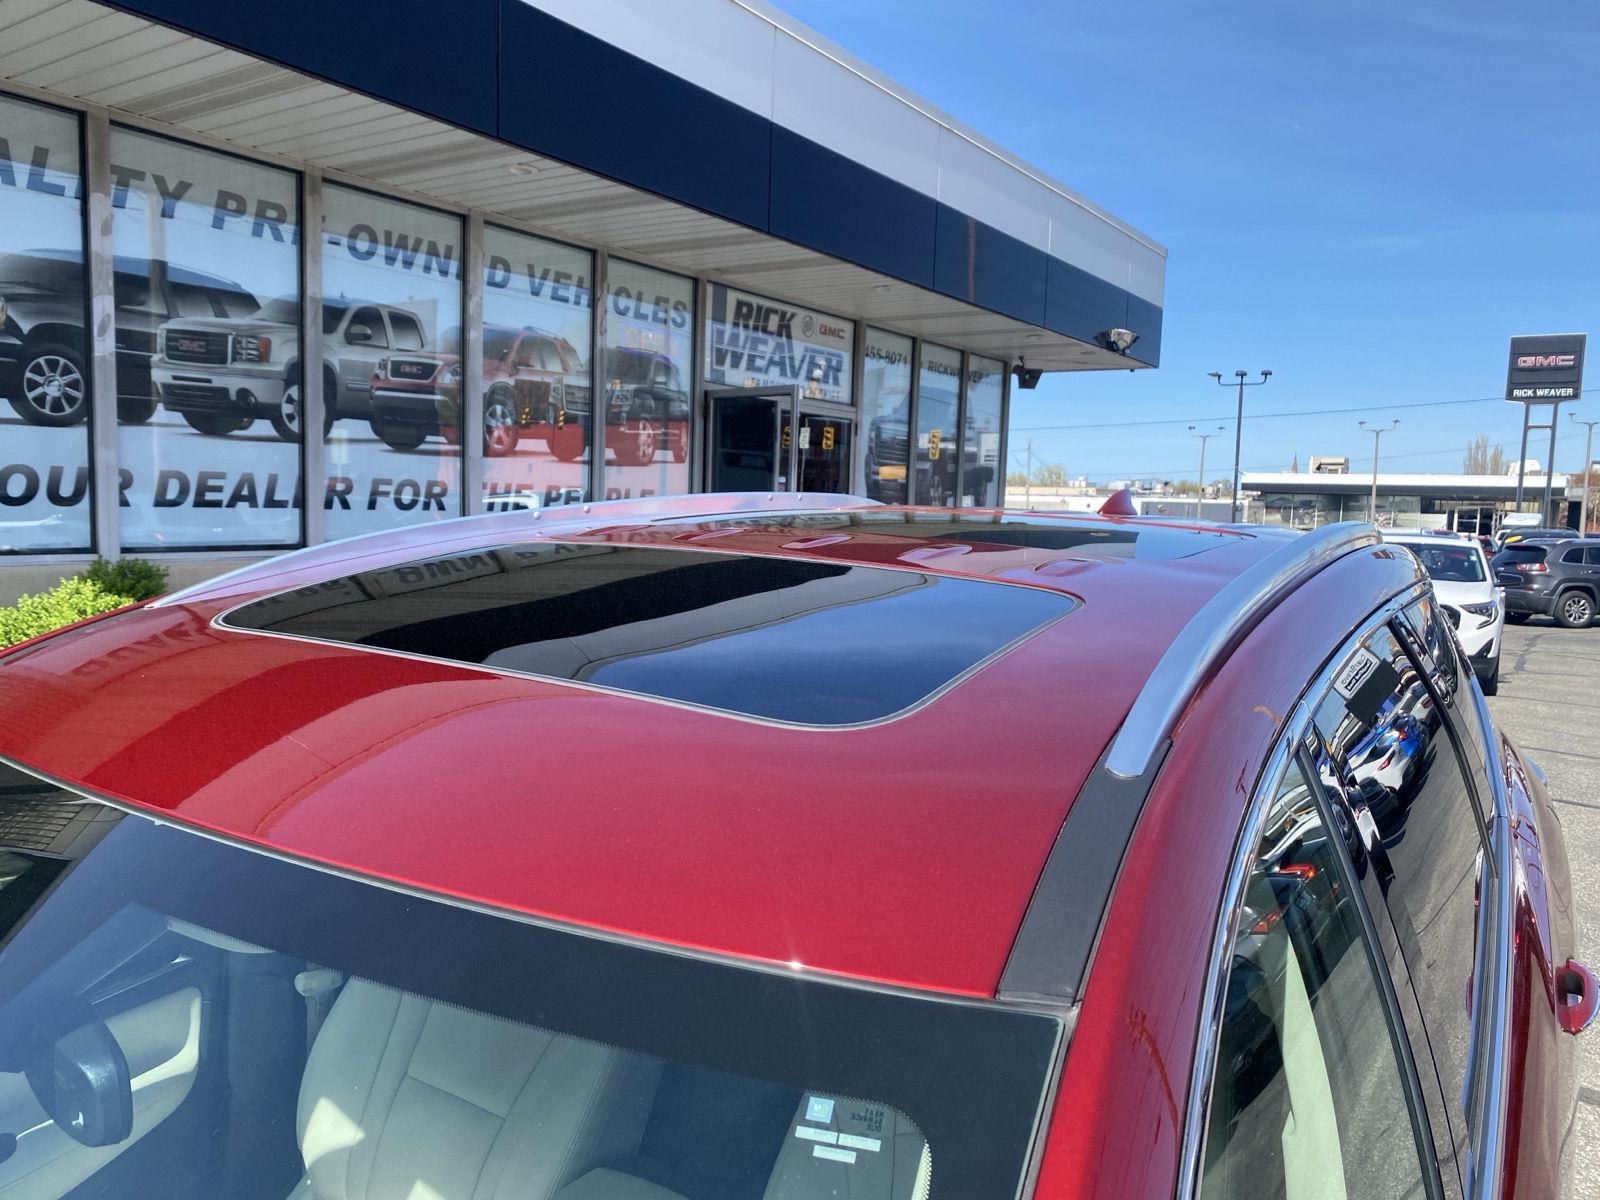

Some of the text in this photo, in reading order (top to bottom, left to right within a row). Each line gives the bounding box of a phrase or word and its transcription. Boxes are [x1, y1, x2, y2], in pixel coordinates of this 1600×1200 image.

[0, 136, 688, 329] LTY PR-OWND VEHCLES
[732, 298, 798, 340] RICK
[818, 324, 846, 340] GMC
[712, 326, 844, 388] WEAVER
[1517, 354, 1575, 368] GMC
[1513, 387, 1574, 398] RICK WEAVER
[153, 469, 354, 511] DEALR
[367, 478, 449, 511] FOR
[482, 482, 534, 512] HE
